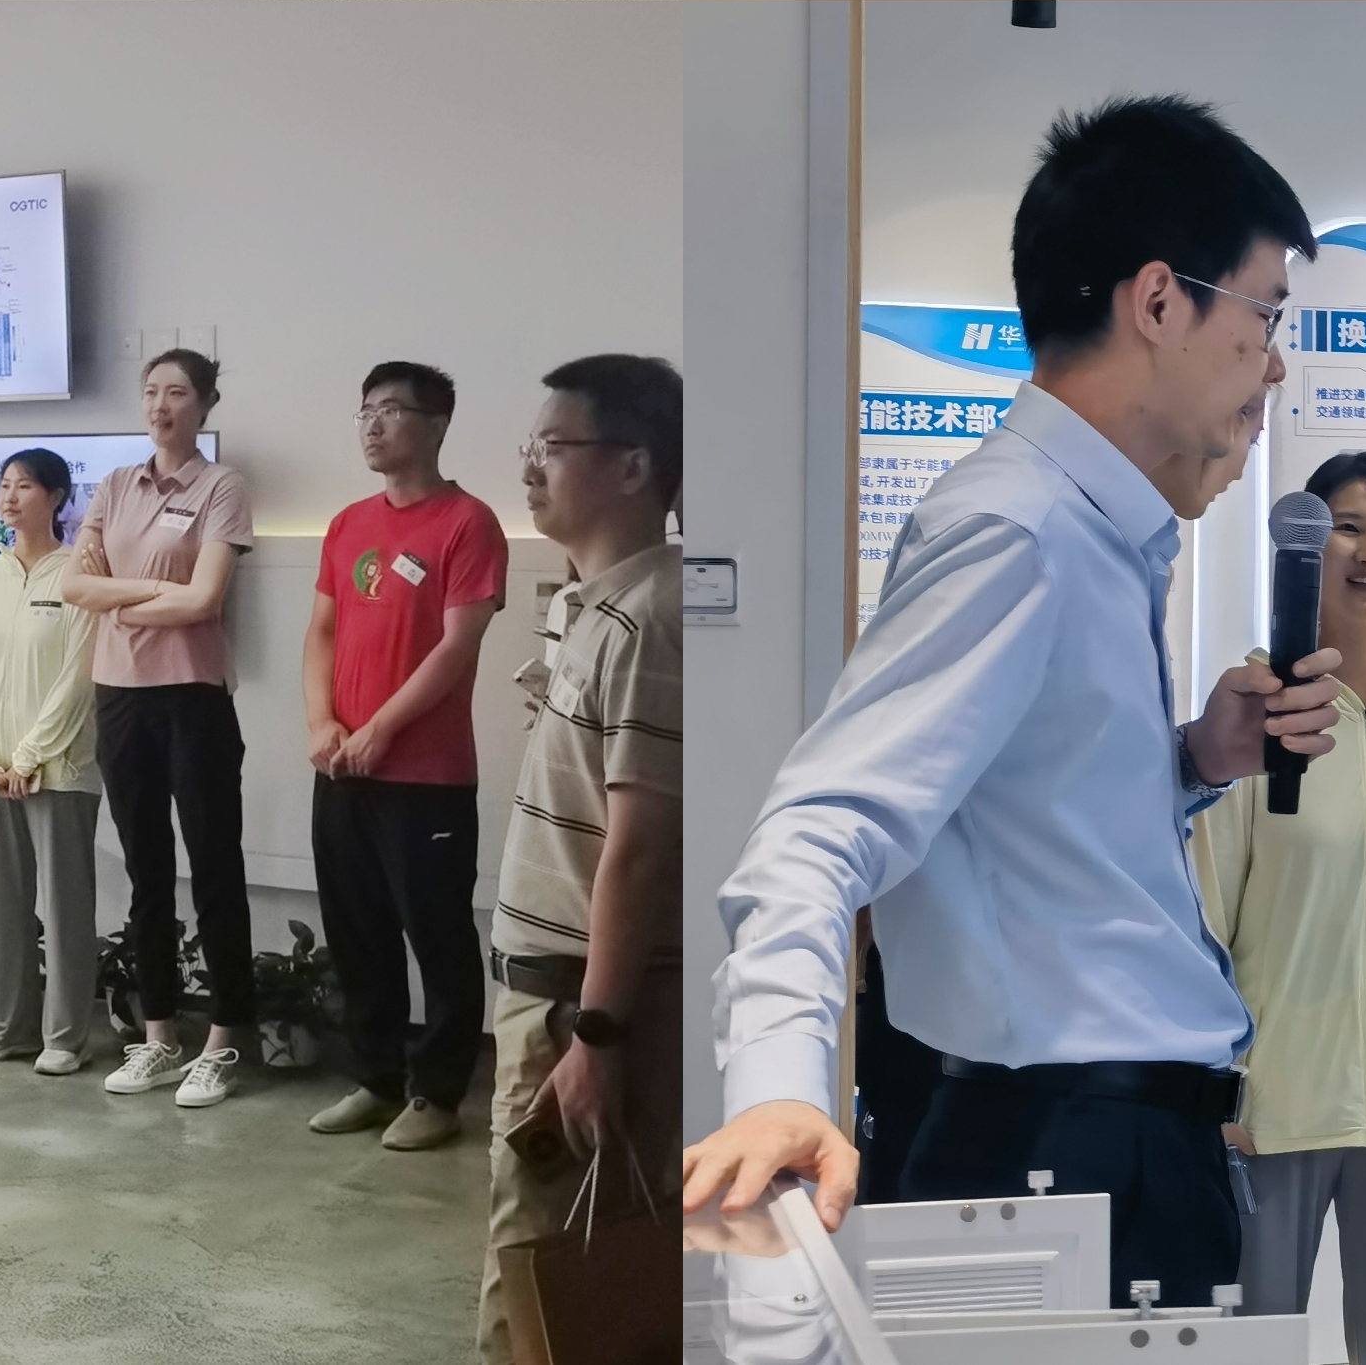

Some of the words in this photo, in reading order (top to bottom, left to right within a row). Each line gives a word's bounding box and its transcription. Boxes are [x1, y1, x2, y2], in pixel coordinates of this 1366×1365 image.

[860, 399, 1010, 435] 能技术部
[860, 456, 957, 472] 部隶属于华能集
